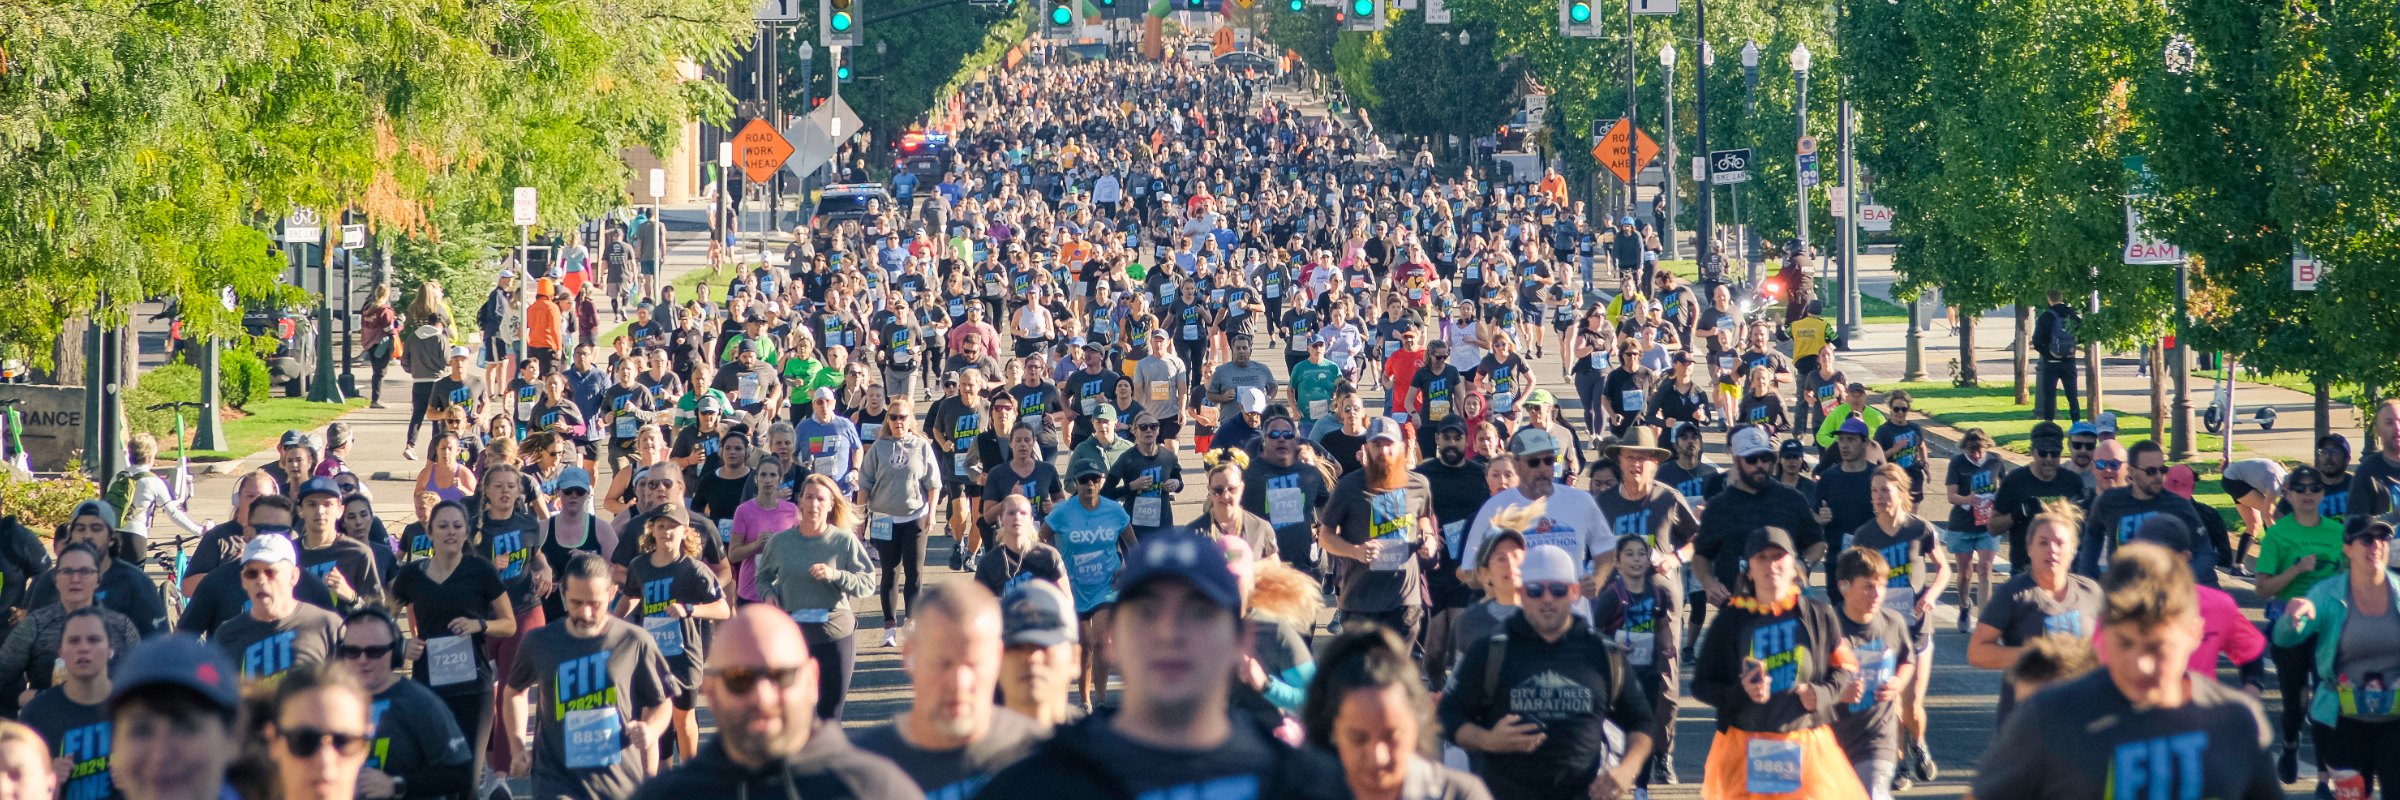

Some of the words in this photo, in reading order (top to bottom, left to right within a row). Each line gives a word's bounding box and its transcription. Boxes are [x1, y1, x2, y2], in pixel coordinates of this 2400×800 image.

[746, 132, 773, 142] ROAD
[1612, 133, 1639, 142] ROA
[746, 146, 774, 156] WORK
[744, 159, 778, 169] AHEAD
[1611, 159, 1645, 168] AHED
[2129, 243, 2175, 258] BAM
[20, 411, 81, 426] RANCE
[1069, 528, 1115, 545] exyte
[1752, 617, 1798, 661] FIT
[246, 631, 298, 682] FIT
[433, 653, 468, 667] 7220
[560, 649, 612, 703] FIT
[1510, 688, 1535, 699] CITY
[1540, 688, 1555, 698] OF
[1557, 687, 1592, 699] TREES
[1510, 697, 1594, 712] MARATHON
[572, 726, 612, 745] 8837
[2114, 729, 2209, 799] FIT
